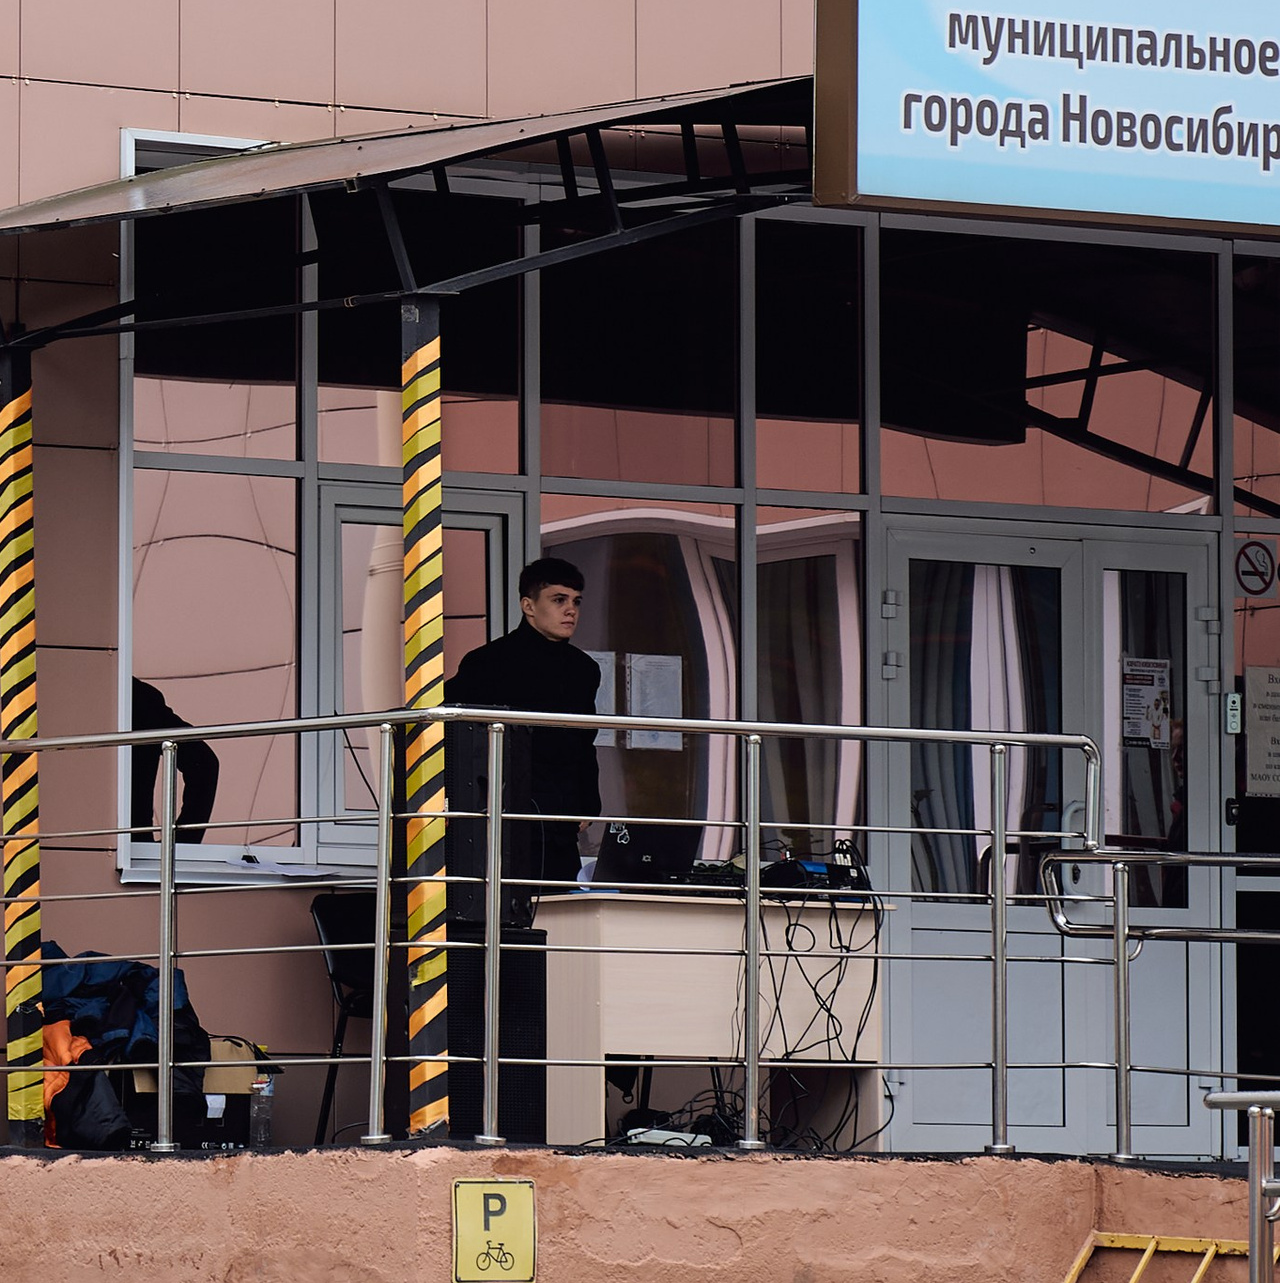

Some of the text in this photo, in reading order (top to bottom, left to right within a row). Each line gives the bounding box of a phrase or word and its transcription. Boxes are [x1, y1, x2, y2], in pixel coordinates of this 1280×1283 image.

[948, 12, 1280, 77] муниципальное
[903, 92, 1280, 172] города Новосибир
[1268, 673, 1280, 684] Вх
[482, 1192, 507, 1232] P
